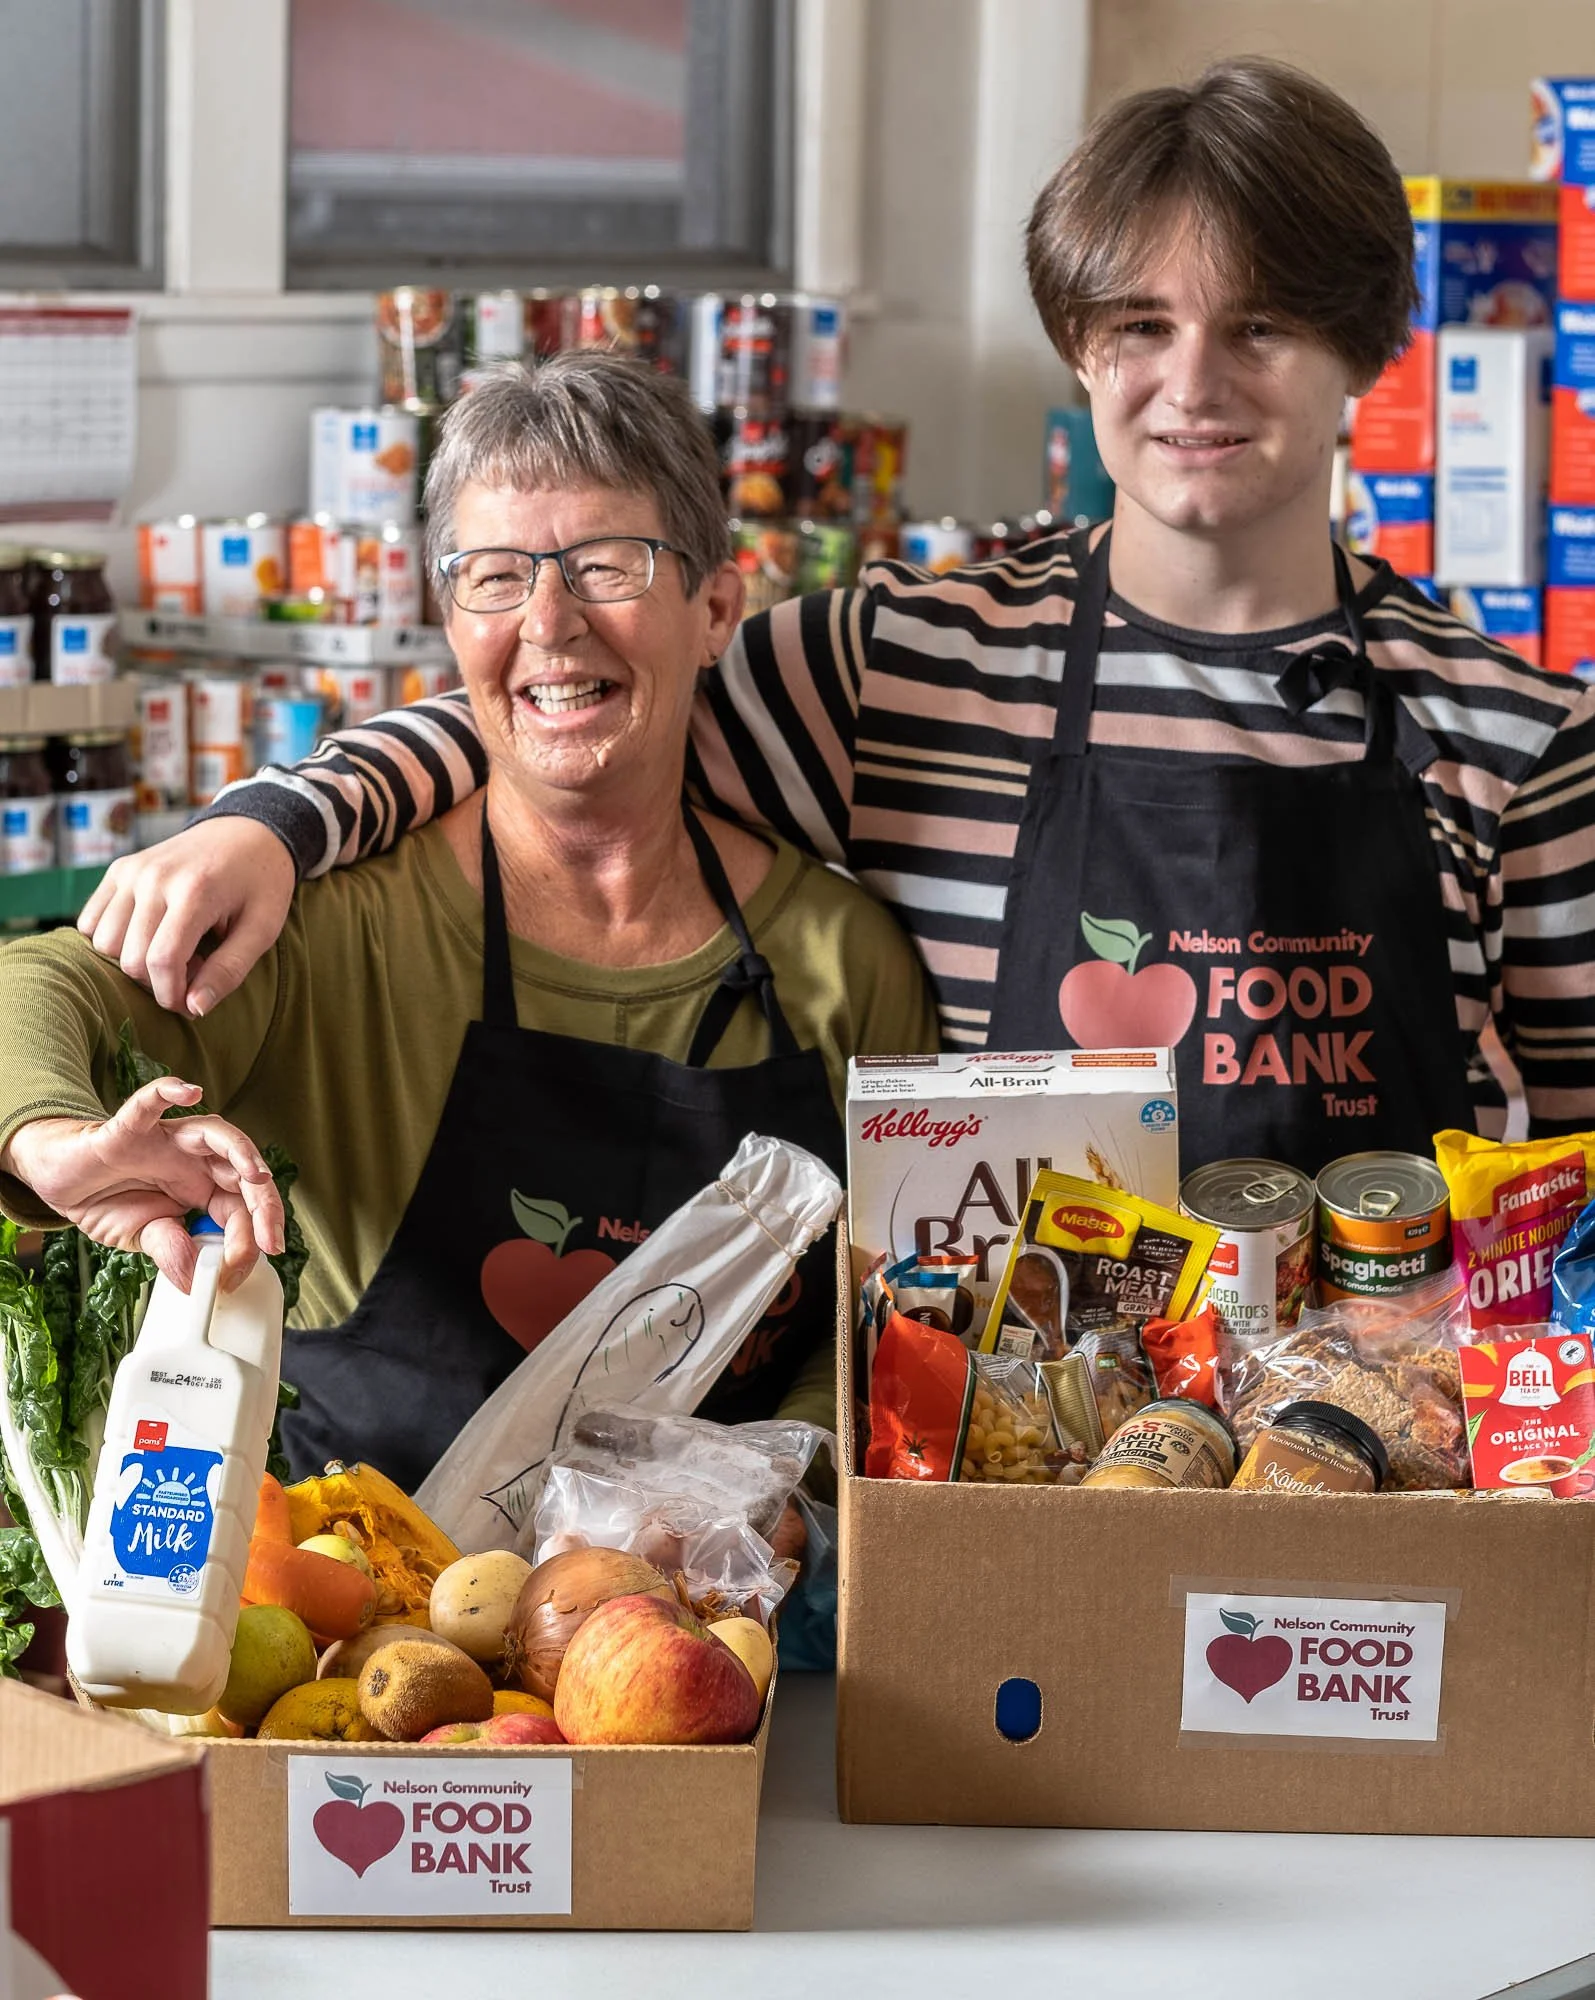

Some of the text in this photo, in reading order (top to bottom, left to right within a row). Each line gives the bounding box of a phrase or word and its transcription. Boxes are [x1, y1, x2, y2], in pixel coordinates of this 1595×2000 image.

[1168, 927, 1374, 957] Nelson Community
[1206, 965, 1373, 1020] FOOD
[1203, 1030, 1377, 1085] BANK
[969, 1076, 1049, 1088] All-Bran
[1322, 1092, 1378, 1117] Trust
[861, 1108, 982, 1147] Kellogg's
[1498, 1167, 1581, 1214] Fantastic
[597, 1216, 651, 1244] Nels
[1060, 1212, 1117, 1235] Maggi
[1467, 1251, 1477, 1269] 2
[1481, 1231, 1527, 1265] MINUTE
[1096, 1257, 1173, 1287] ROAST
[1321, 1243, 1427, 1281] Spaghetti
[1104, 1276, 1171, 1301] MEAT
[1342, 1279, 1375, 1292] Tomato
[1375, 1284, 1404, 1293] Sauce
[1469, 1246, 1557, 1310] ORIE
[1123, 1303, 1155, 1314] GRAVY
[1211, 1301, 1269, 1319] OMATOES
[150, 1376, 175, 1385] BEFORE
[175, 1374, 191, 1386] 24
[1509, 1370, 1551, 1387] BELL
[1524, 1418, 1542, 1426] THE
[1113, 1432, 1171, 1447] ANUT
[1490, 1423, 1580, 1446] ORIGINAL
[1512, 1440, 1561, 1452] BLACK TEA
[1110, 1440, 1162, 1453] TTER
[1330, 1458, 1354, 1474] HONEY
[132, 1503, 205, 1523] STANDARD
[128, 1521, 198, 1556] Milk
[103, 1579, 124, 1588] LITRE
[1274, 1617, 1415, 1637] Nelson Community
[1299, 1637, 1414, 1668] FOOD
[1297, 1672, 1412, 1704] BANK
[1370, 1707, 1410, 1721] Trust
[383, 1780, 533, 1798] Nelson Community
[412, 1801, 533, 1834] FOOD
[411, 1841, 533, 1875] BANK
[489, 1879, 532, 1894] Trust
